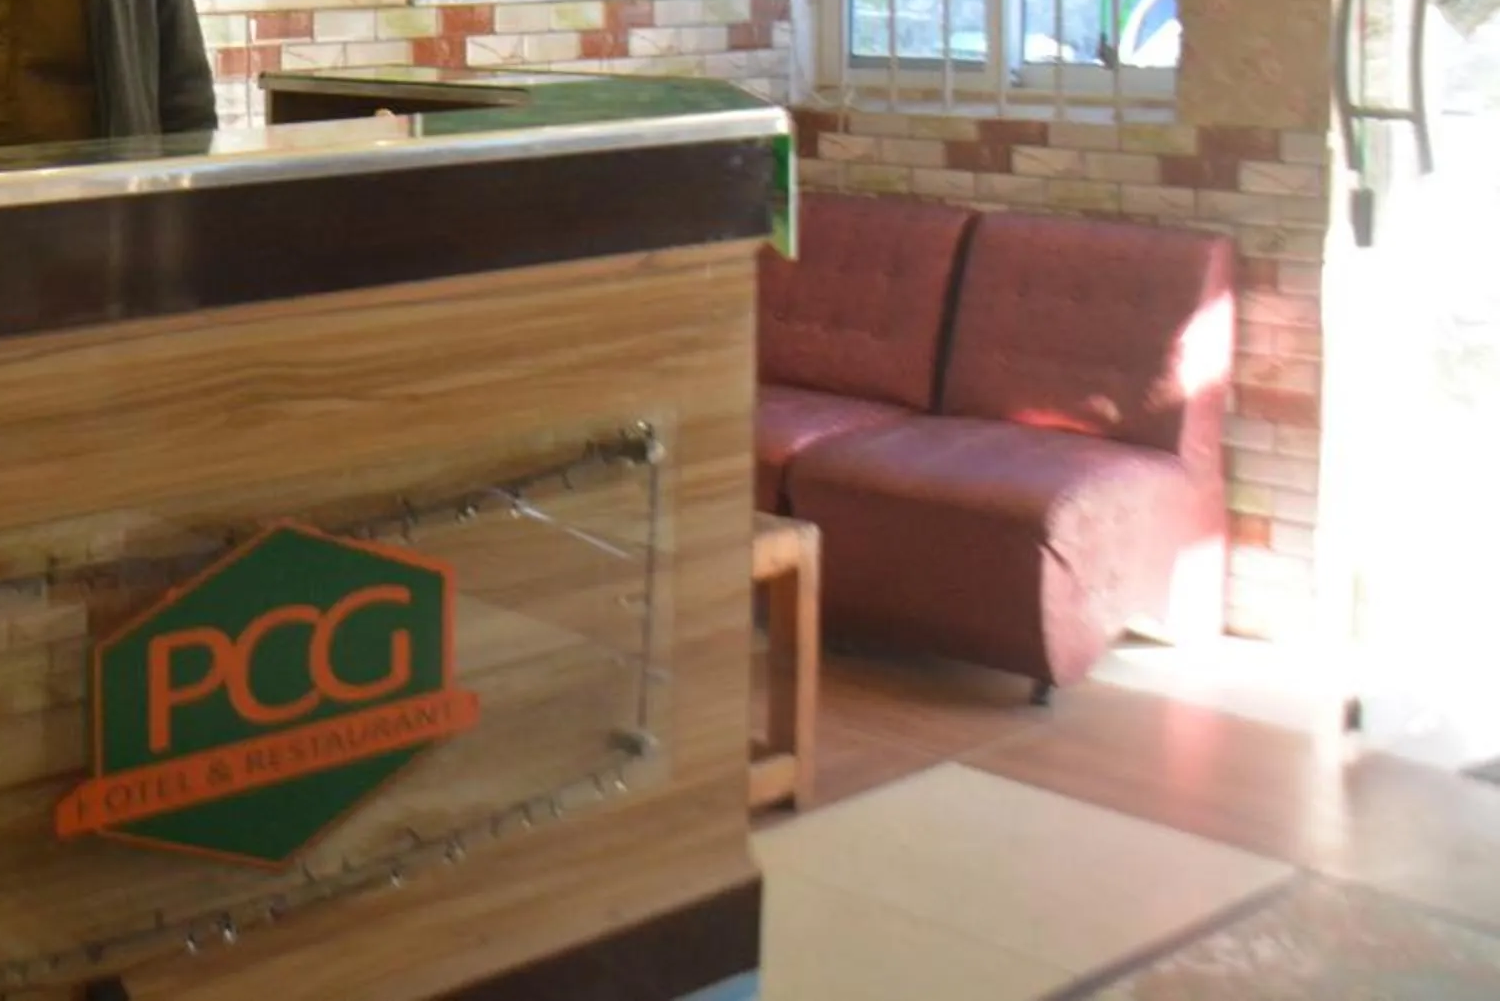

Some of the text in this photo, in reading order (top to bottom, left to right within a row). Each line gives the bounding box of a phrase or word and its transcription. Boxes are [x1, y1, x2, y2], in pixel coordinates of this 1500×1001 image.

[148, 583, 412, 755] PCG
[205, 757, 235, 787] &
[244, 701, 453, 776] RESTAURANT
